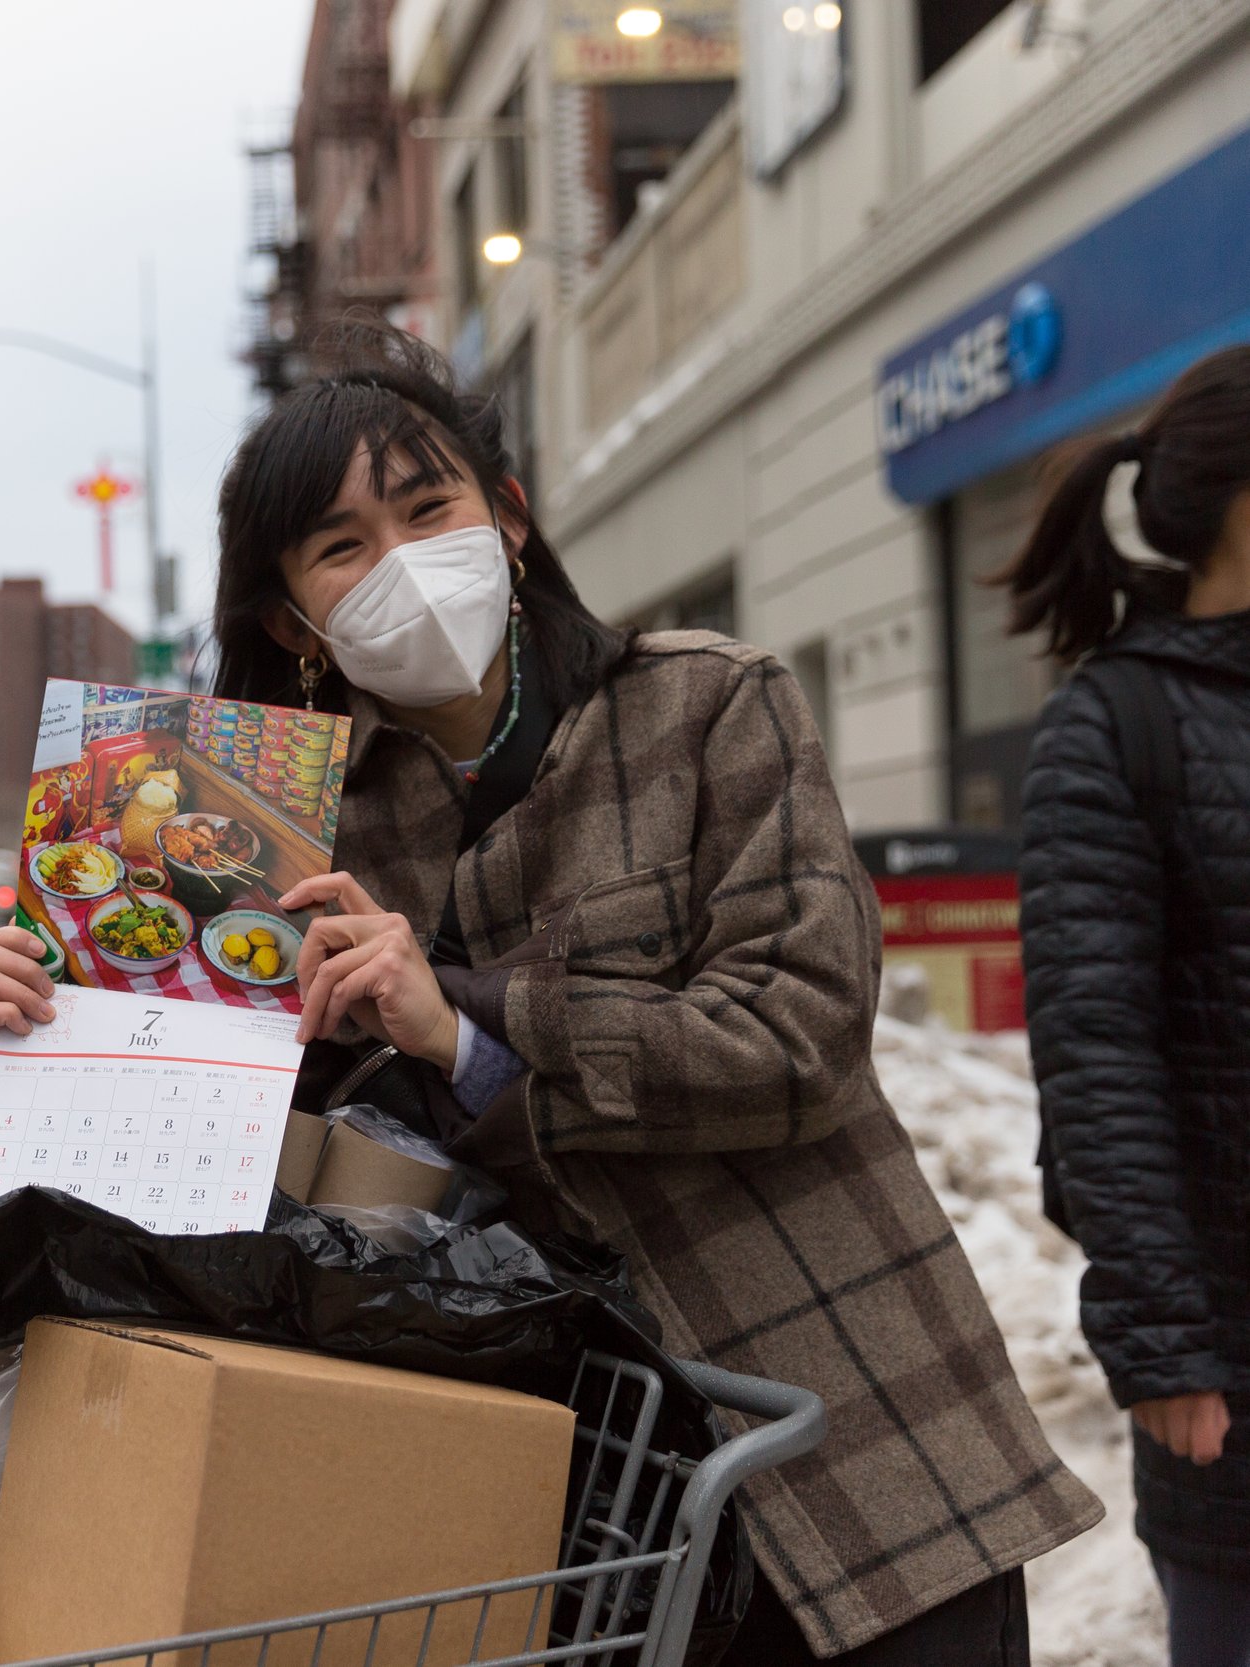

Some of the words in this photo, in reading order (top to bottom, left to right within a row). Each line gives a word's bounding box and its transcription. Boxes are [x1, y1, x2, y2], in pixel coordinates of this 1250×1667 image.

[876, 313, 1012, 452] CHASE
[142, 1010, 164, 1031] 7
[128, 1033, 162, 1050] July
[173, 1086, 177, 1095] 1
[213, 1089, 221, 1098] 2
[256, 1092, 263, 1101] 3
[5, 1115, 12, 1124] 4
[44, 1116, 52, 1125] 5
[84, 1117, 92, 1127] 6
[125, 1118, 132, 1127] 7
[165, 1119, 173, 1129] 8
[207, 1121, 214, 1130] 9
[246, 1123, 260, 1132] 10
[35, 1149, 47, 1159] 12
[75, 1151, 87, 1160] 13
[115, 1152, 128, 1161] 14
[156, 1153, 169, 1163] 15
[198, 1155, 211, 1165] 16
[241, 1157, 254, 1167] 17
[66, 1184, 81, 1194] 20
[107, 1185, 120, 1195] 21
[148, 1187, 163, 1197] 22
[190, 1189, 205, 1199] 23
[232, 1191, 247, 1200] 24
[141, 1220, 156, 1231] 29
[181, 1222, 198, 1232] 30
[226, 1223, 239, 1232] 31
